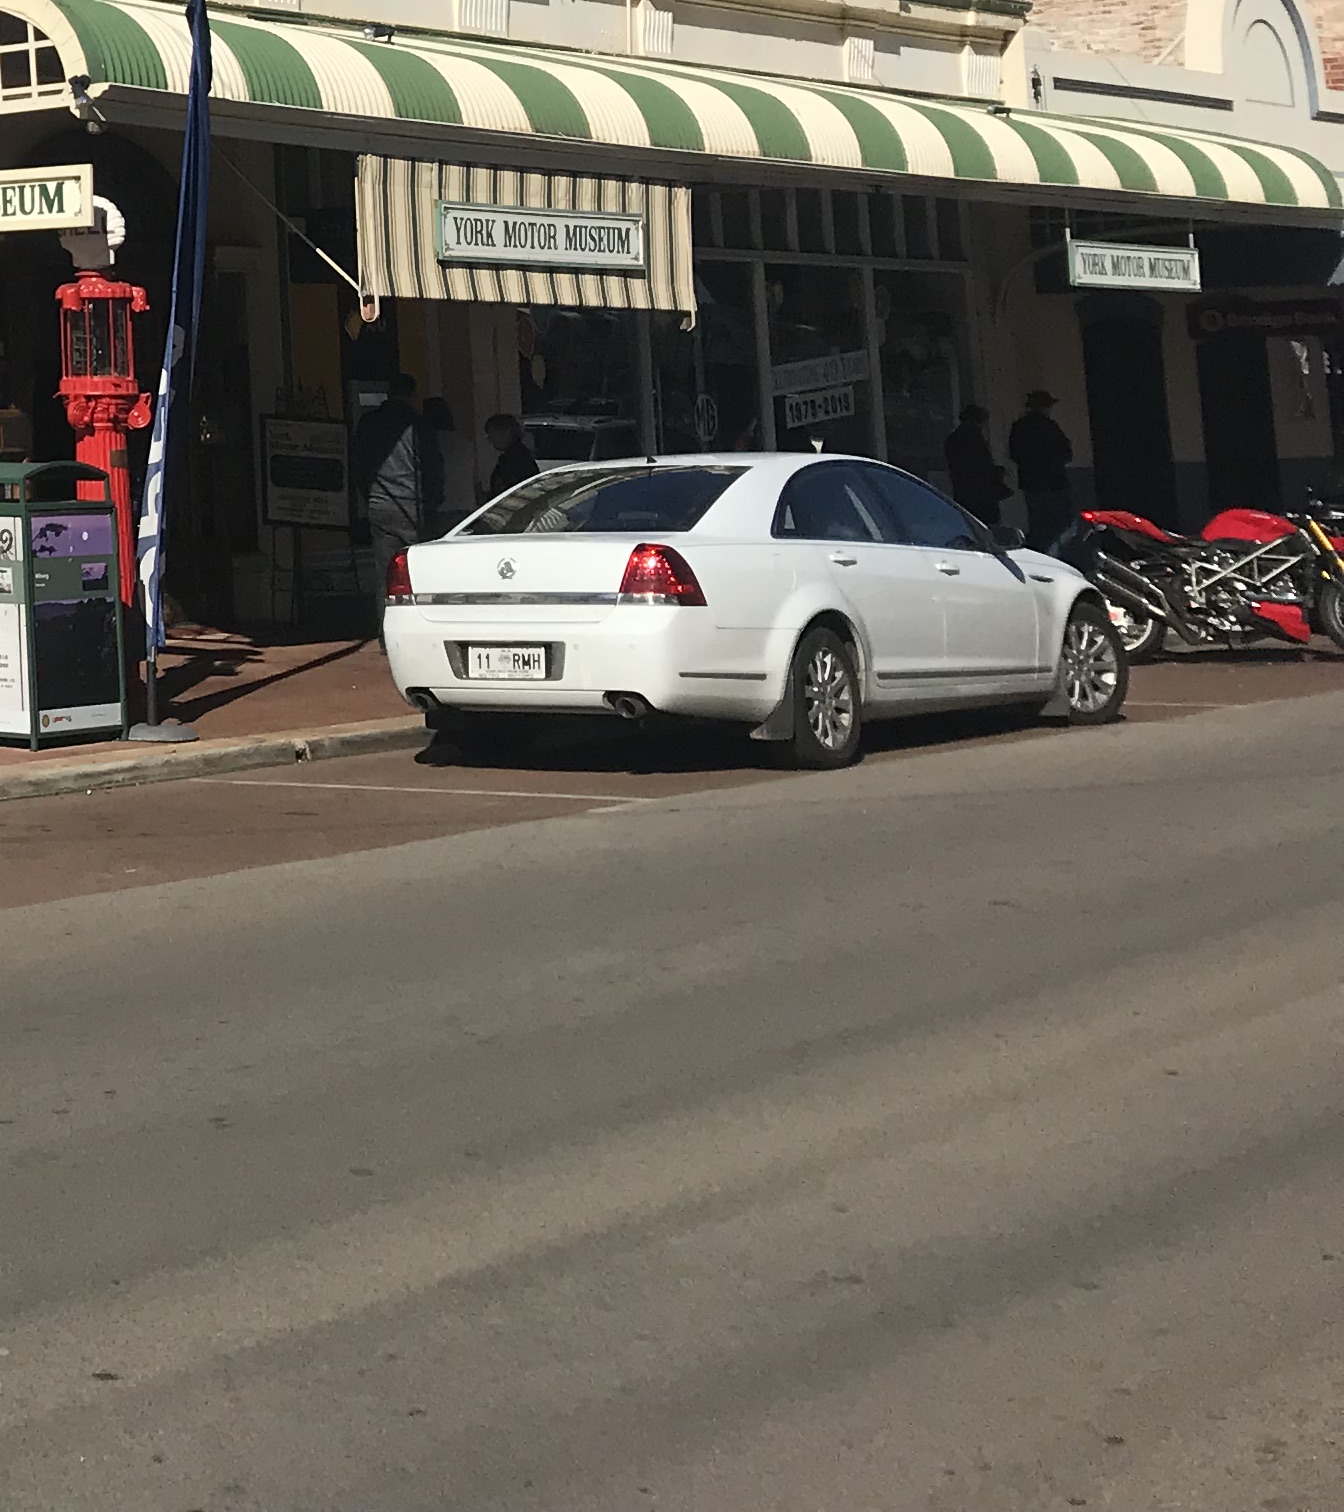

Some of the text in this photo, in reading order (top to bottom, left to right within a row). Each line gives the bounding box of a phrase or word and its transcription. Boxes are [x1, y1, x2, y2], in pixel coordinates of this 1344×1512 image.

[453, 216, 632, 255] YORK MOTOR MUSEUM
[1080, 252, 1192, 281] YORK MOTOR MUSEUM
[477, 653, 541, 670] 11 RMH
